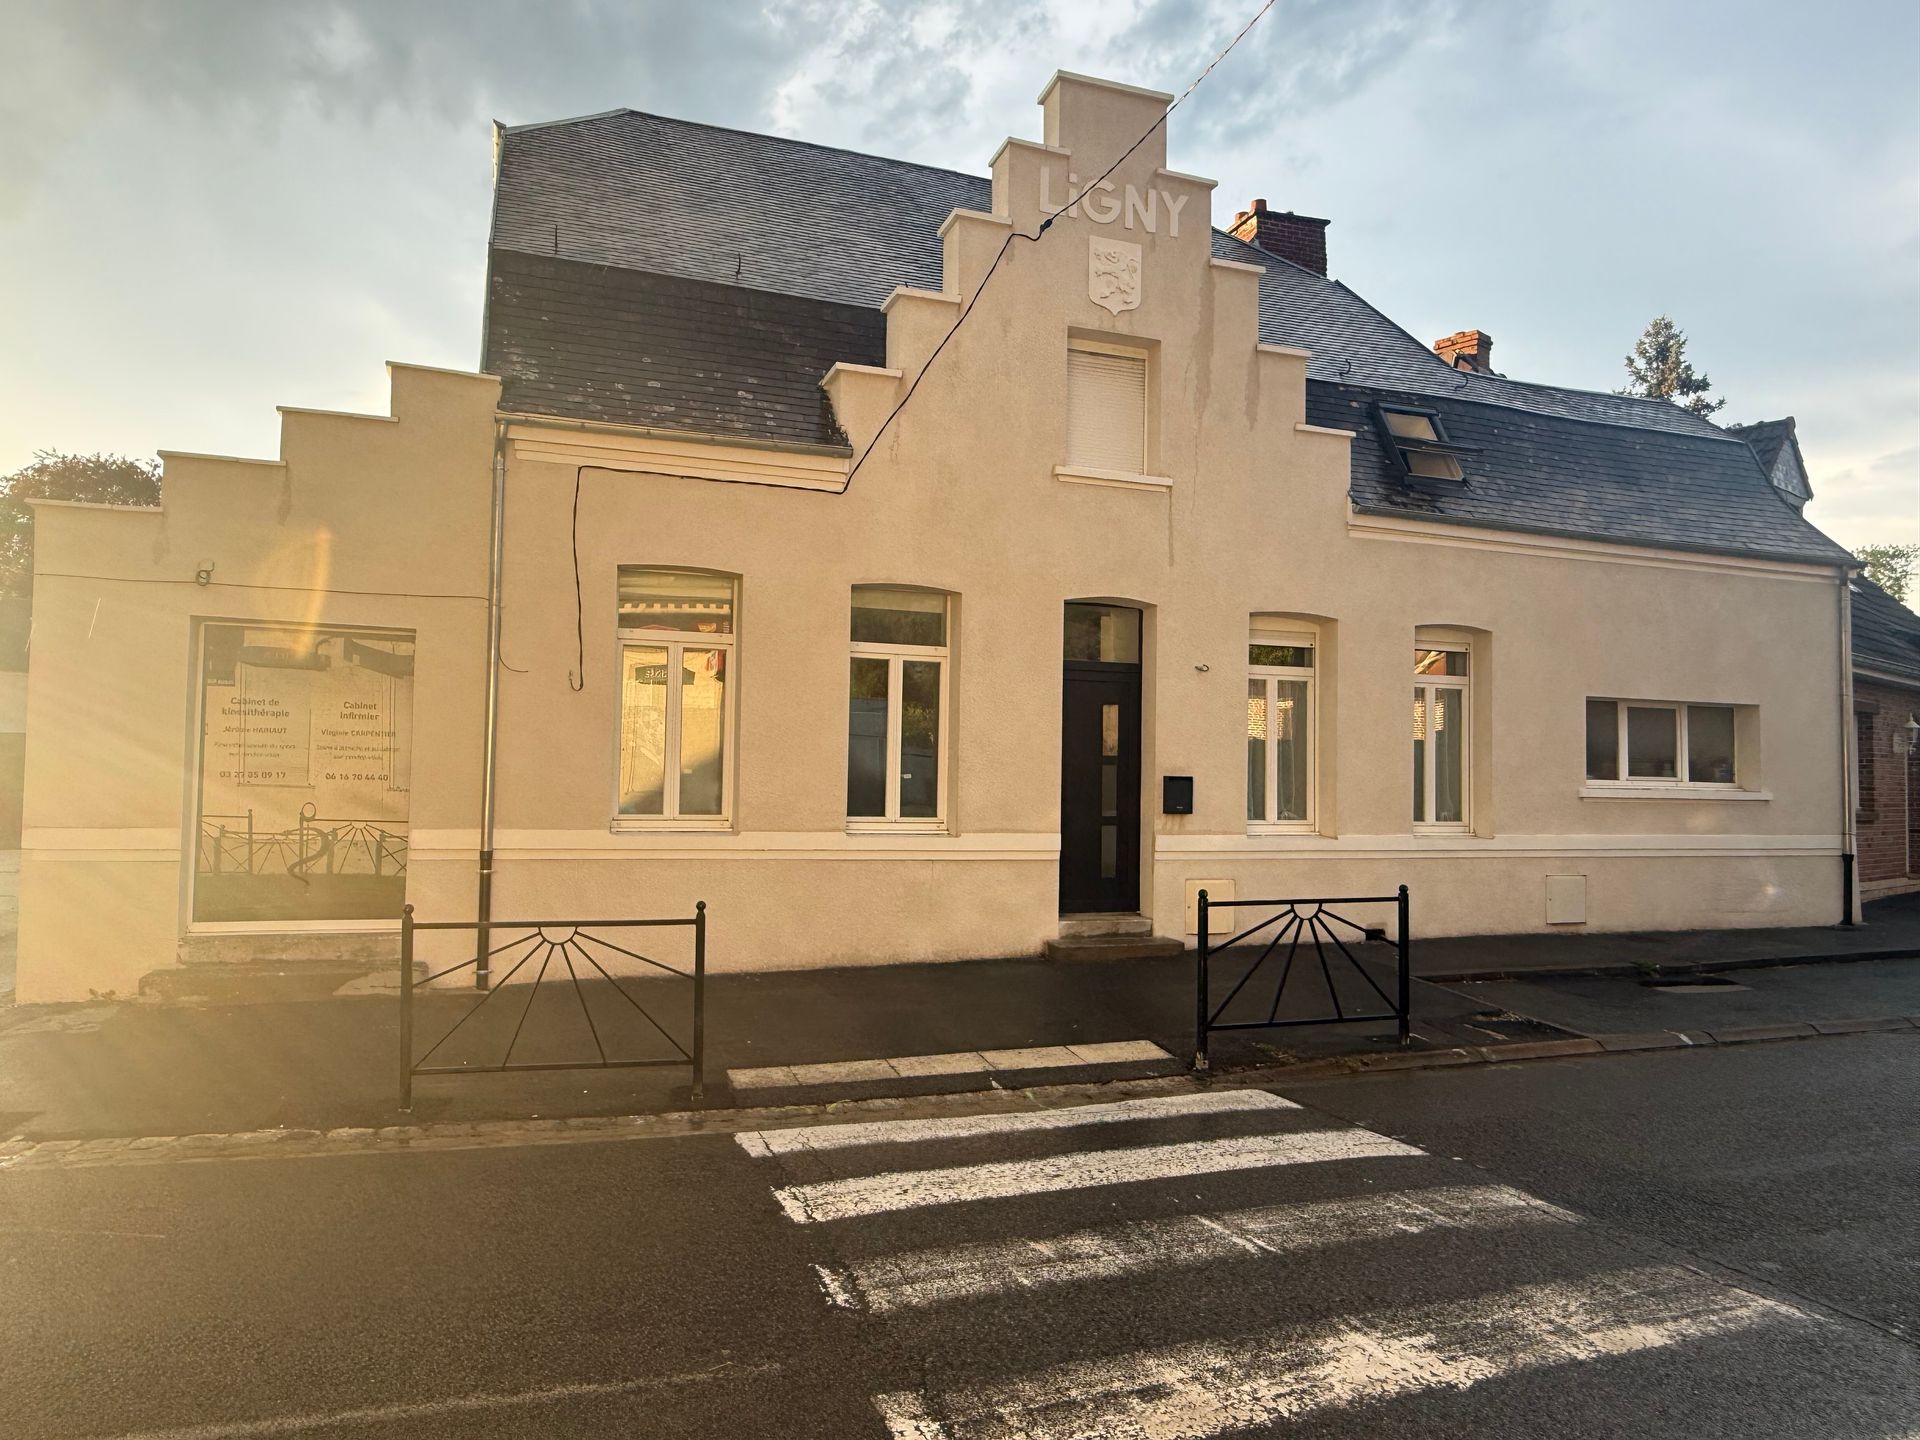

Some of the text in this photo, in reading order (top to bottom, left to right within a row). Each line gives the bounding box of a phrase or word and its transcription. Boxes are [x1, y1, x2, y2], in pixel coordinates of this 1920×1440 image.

[231, 697, 281, 707] Cabinet de
[344, 701, 377, 711] Cabinet
[321, 728, 350, 737] Virginie
[339, 773, 350, 781] 16
[351, 773, 363, 781] 70
[364, 773, 376, 781] 44
[377, 774, 389, 782] 40
